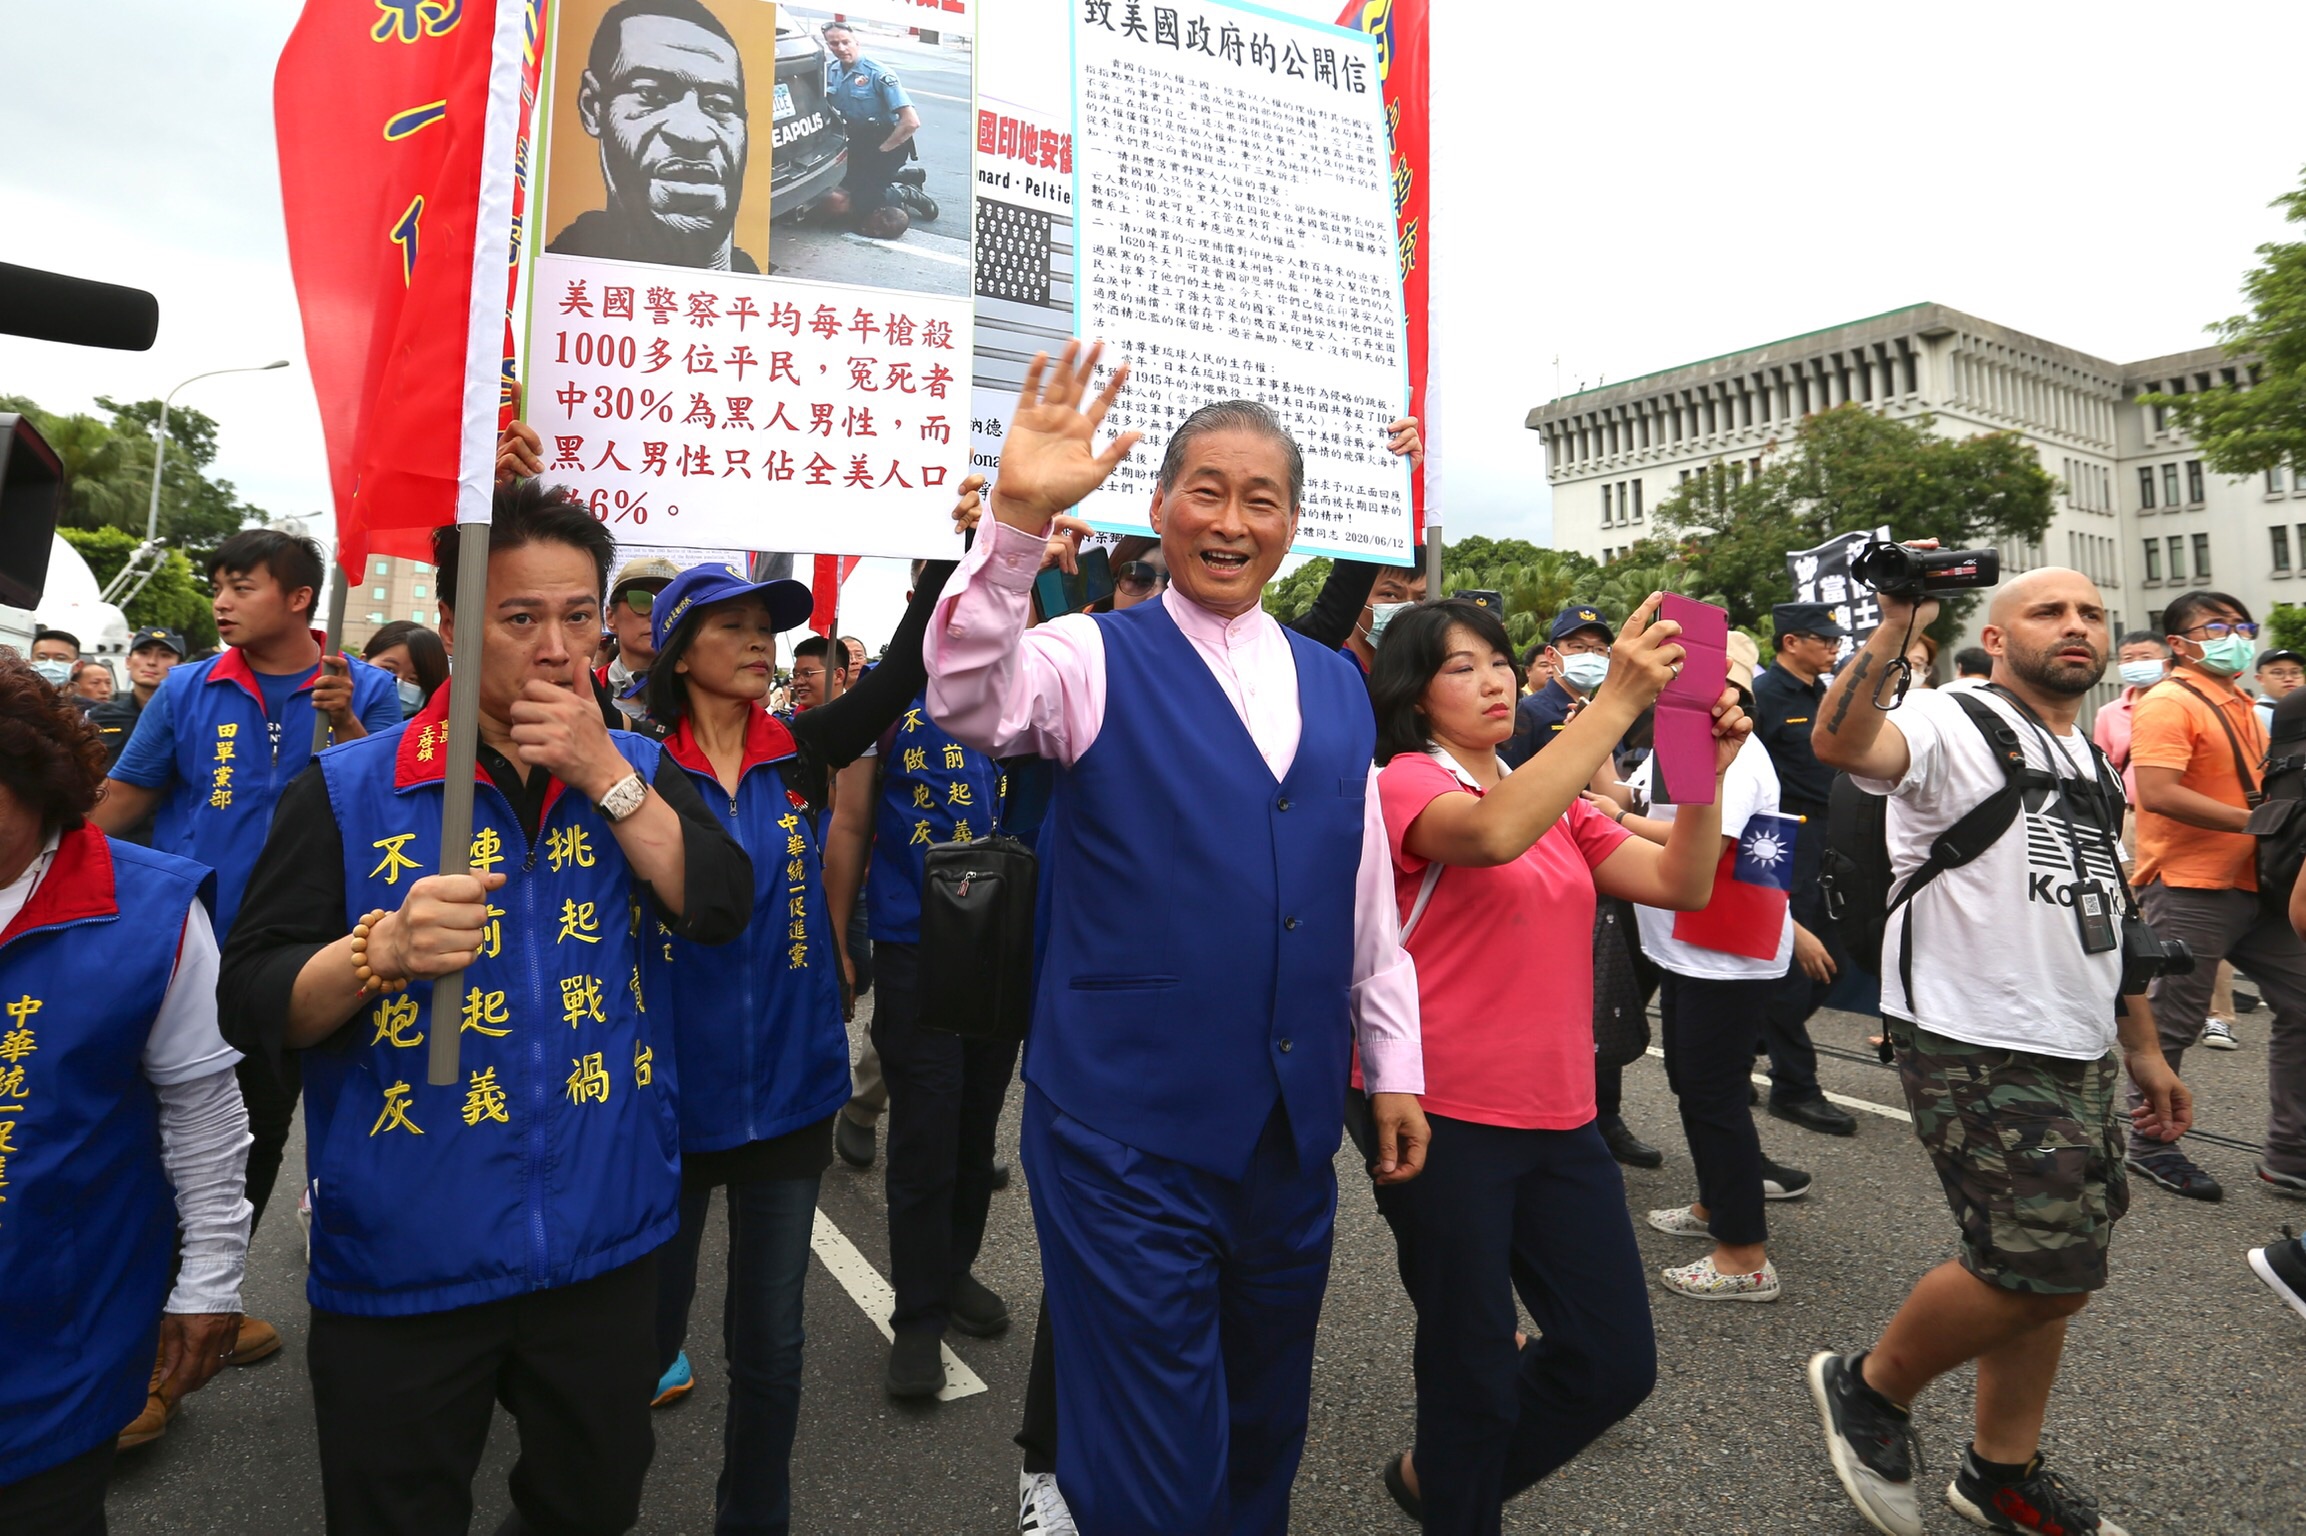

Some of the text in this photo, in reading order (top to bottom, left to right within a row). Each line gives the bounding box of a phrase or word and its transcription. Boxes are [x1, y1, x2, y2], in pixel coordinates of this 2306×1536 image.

[1085, 0, 1367, 94] 致美國政府的公開信
[976, 169, 1010, 189] nard
[1026, 176, 1073, 205] Peltie
[558, 279, 956, 351] 美國警察平均每年槍殺
[554, 330, 955, 401] 1000多位平民，冤死者
[555, 380, 952, 447] 中30%為黑人男性，而
[549, 434, 949, 491] 黑人男性只佔全美人口
[1301, 476, 1401, 503] 訴求予以正面回應
[1344, 531, 1404, 550] 2020/06/12
[208, 723, 239, 810] 田單黨部
[901, 708, 936, 846] 不做炮灰
[777, 813, 809, 970] 中華統一促進黨
[2029, 872, 2122, 915] Kok
[369, 833, 425, 1138] 不炮灰
[545, 825, 609, 1106] 挑起戰禍
